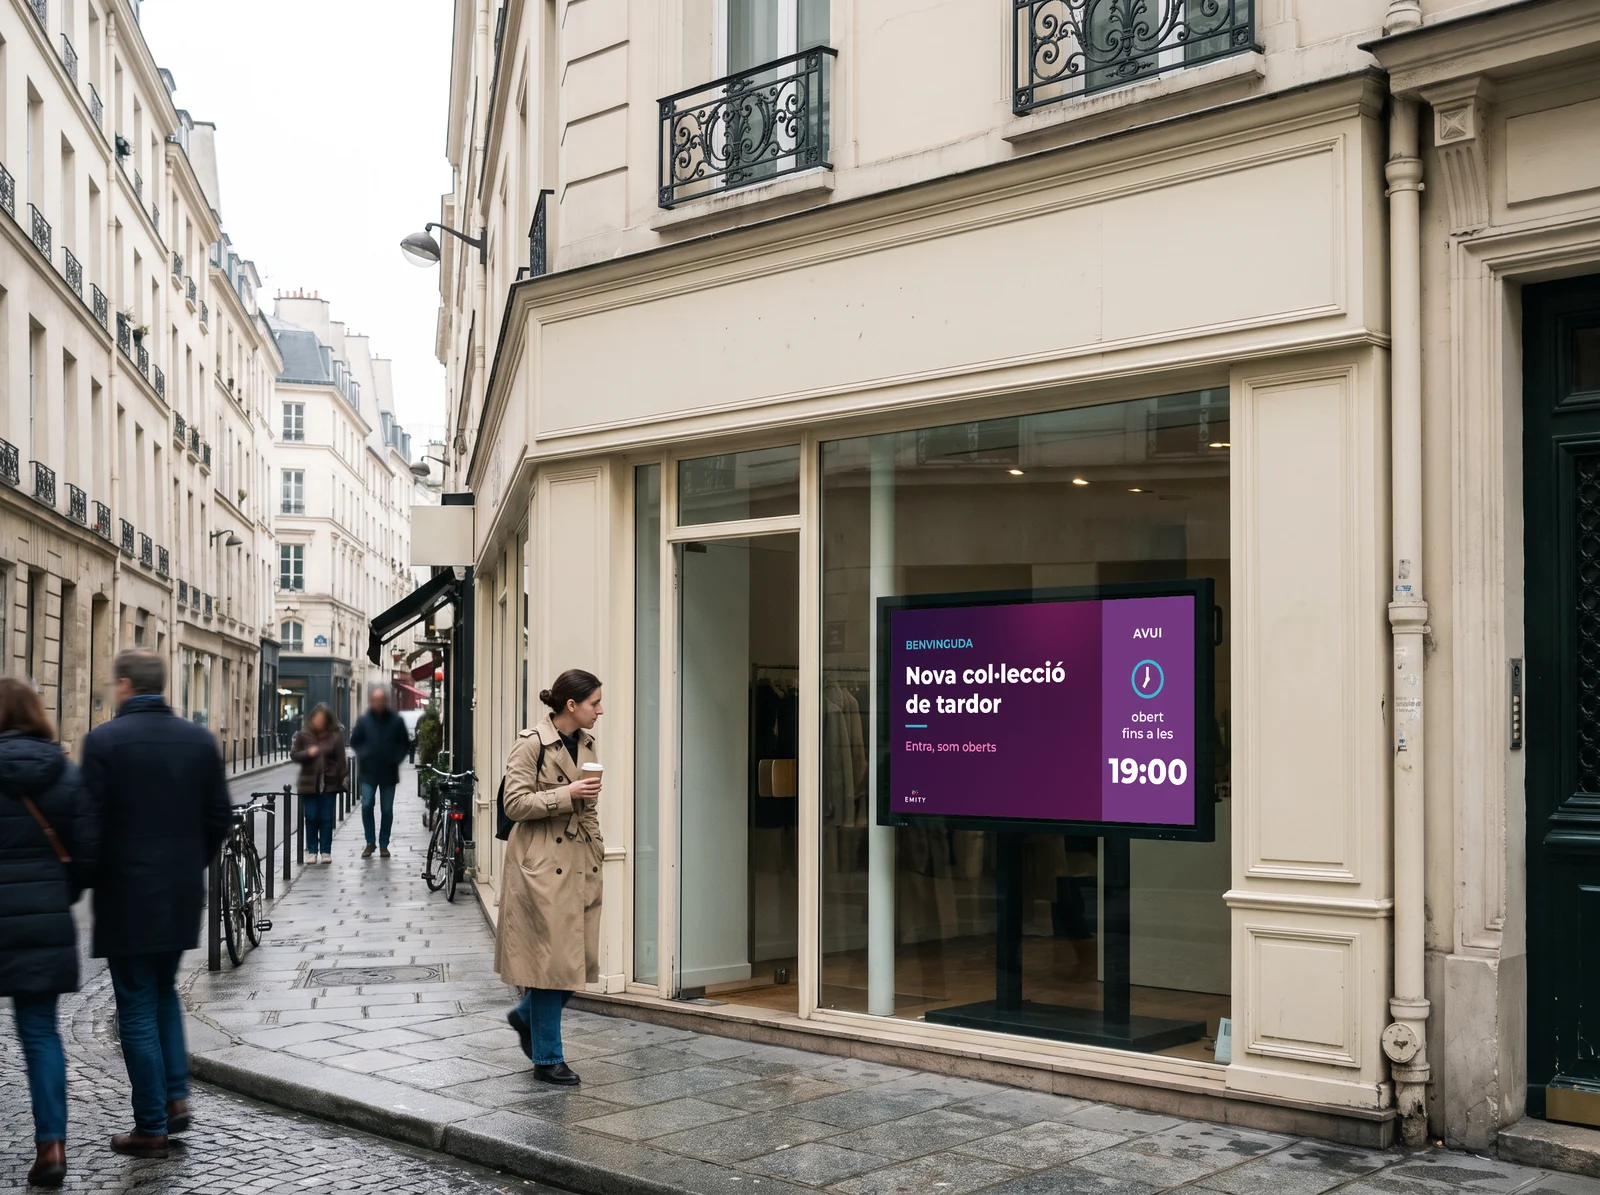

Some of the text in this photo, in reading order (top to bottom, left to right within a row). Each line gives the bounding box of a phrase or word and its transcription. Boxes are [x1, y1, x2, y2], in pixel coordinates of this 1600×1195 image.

[1133, 628, 1162, 639] AVUI
[906, 638, 973, 650] BENVINGUDA
[906, 660, 1066, 685] Nova col·lecció
[906, 693, 1002, 714] de tardor
[1131, 711, 1164, 723] obert
[1122, 727, 1174, 740] fins a les
[905, 741, 997, 754] Entra, som oberts
[1108, 757, 1188, 786] 19:00
